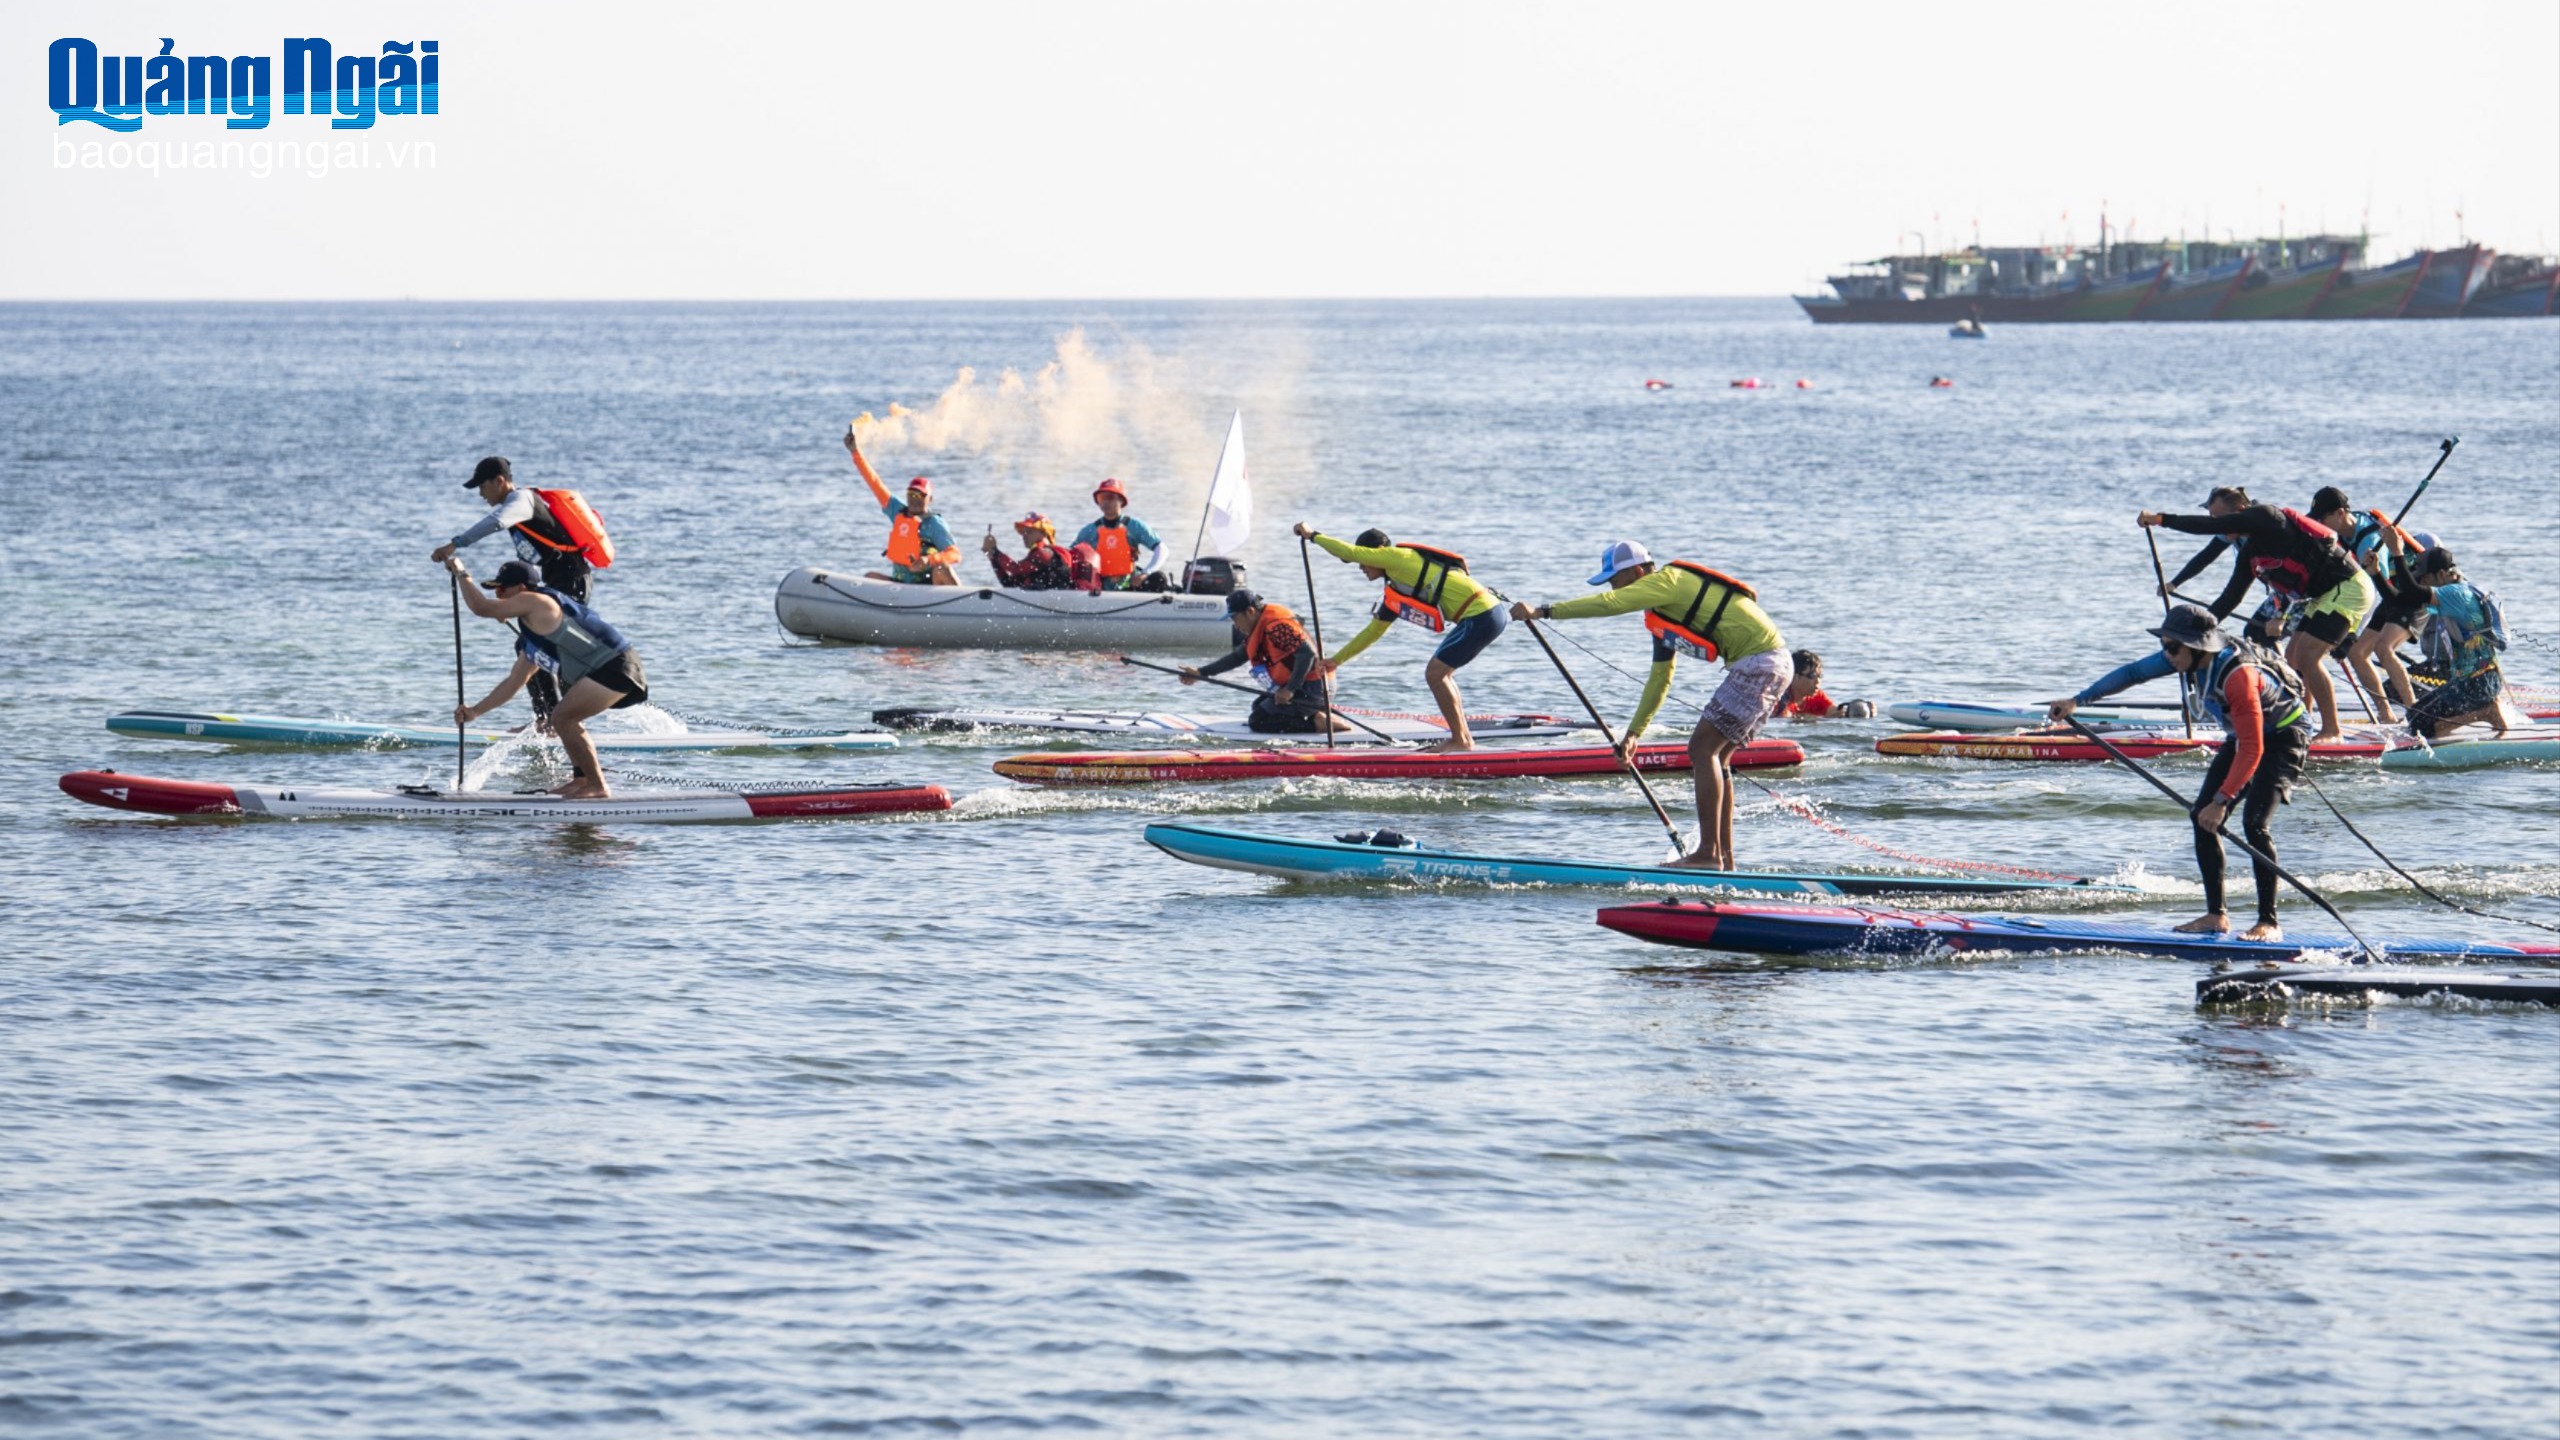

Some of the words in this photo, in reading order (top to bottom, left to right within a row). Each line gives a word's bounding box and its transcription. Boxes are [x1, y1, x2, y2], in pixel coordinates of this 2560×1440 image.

[1964, 746, 2001, 756] AQUA
[2006, 746, 2060, 756] MARINA
[1637, 755, 1667, 765] RACE
[1080, 768, 1118, 779] AQUA
[1124, 768, 1177, 778] MARINA
[1421, 861, 1512, 878] TRANS-E
